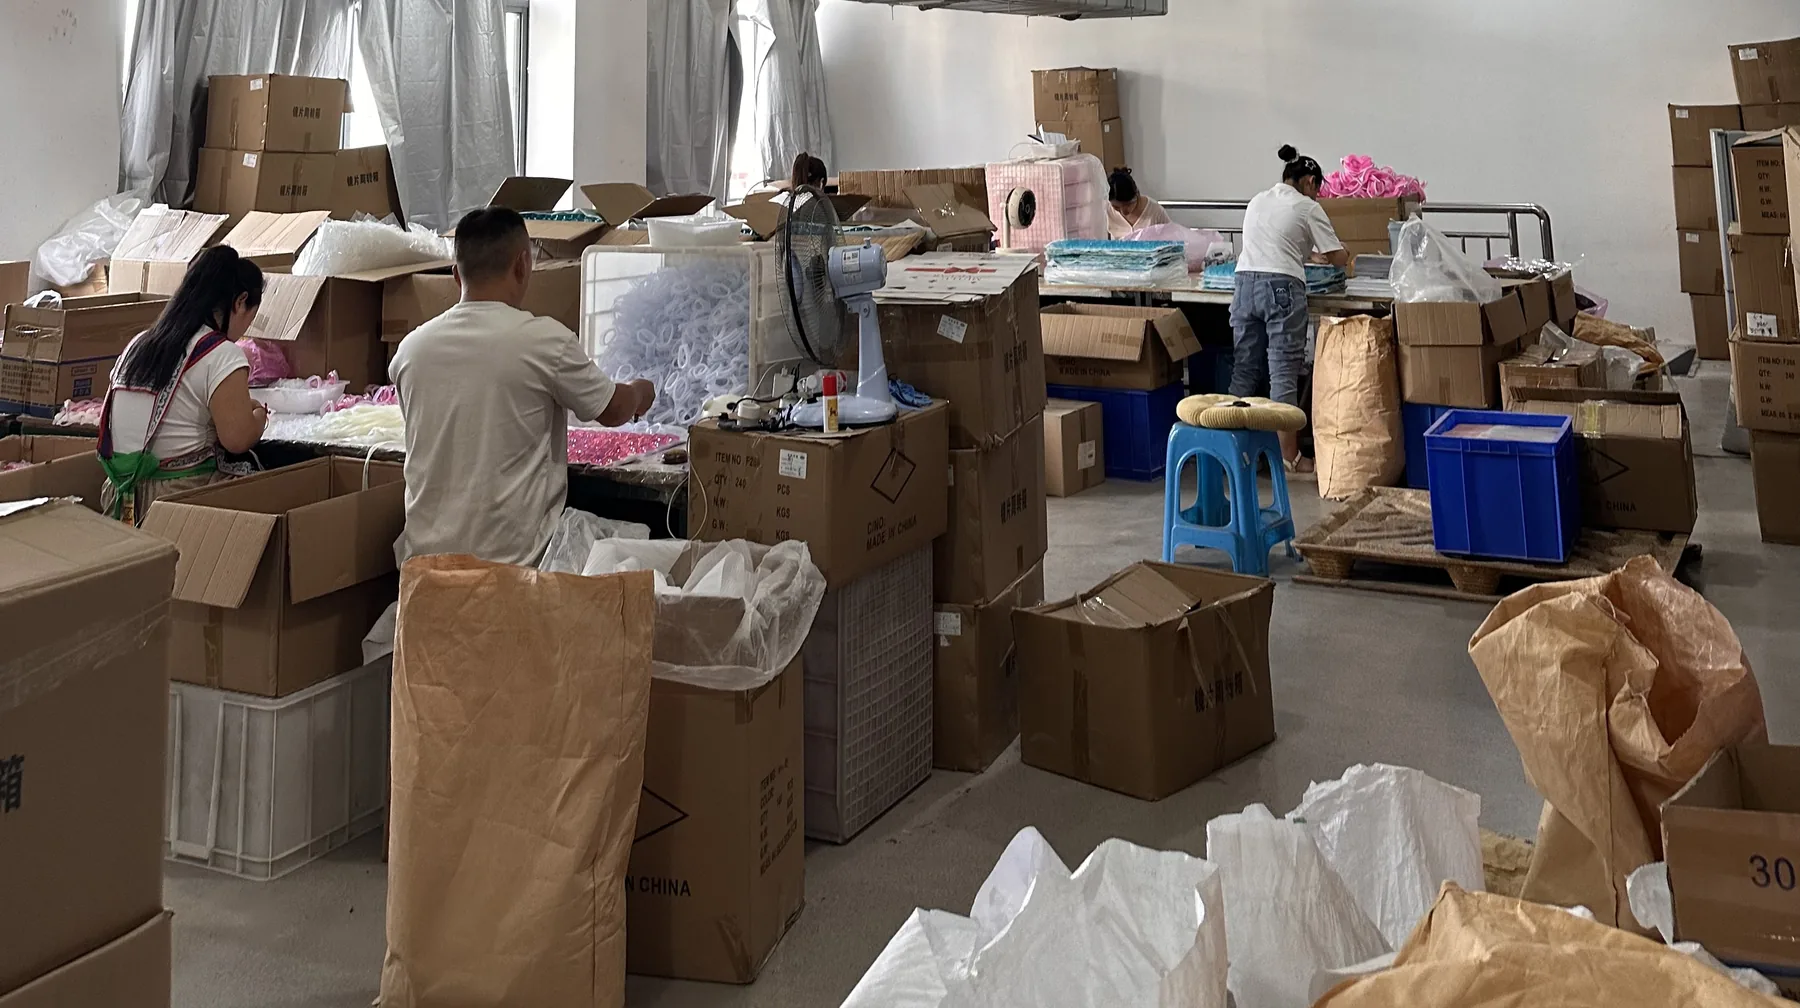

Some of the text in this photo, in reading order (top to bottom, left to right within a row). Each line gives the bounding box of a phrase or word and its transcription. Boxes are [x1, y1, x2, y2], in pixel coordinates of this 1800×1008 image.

[1089, 367, 1111, 377] CHINA
[715, 452, 731, 464] ITEM
[735, 478, 747, 489] 240
[777, 484, 791, 496] PCS
[776, 506, 791, 519] KGS
[1605, 500, 1637, 512] CHINA
[775, 529, 790, 541] KGS
[866, 530, 886, 551] MADE
[1750, 855, 1796, 891] 30
[624, 875, 691, 897] N CHINA
